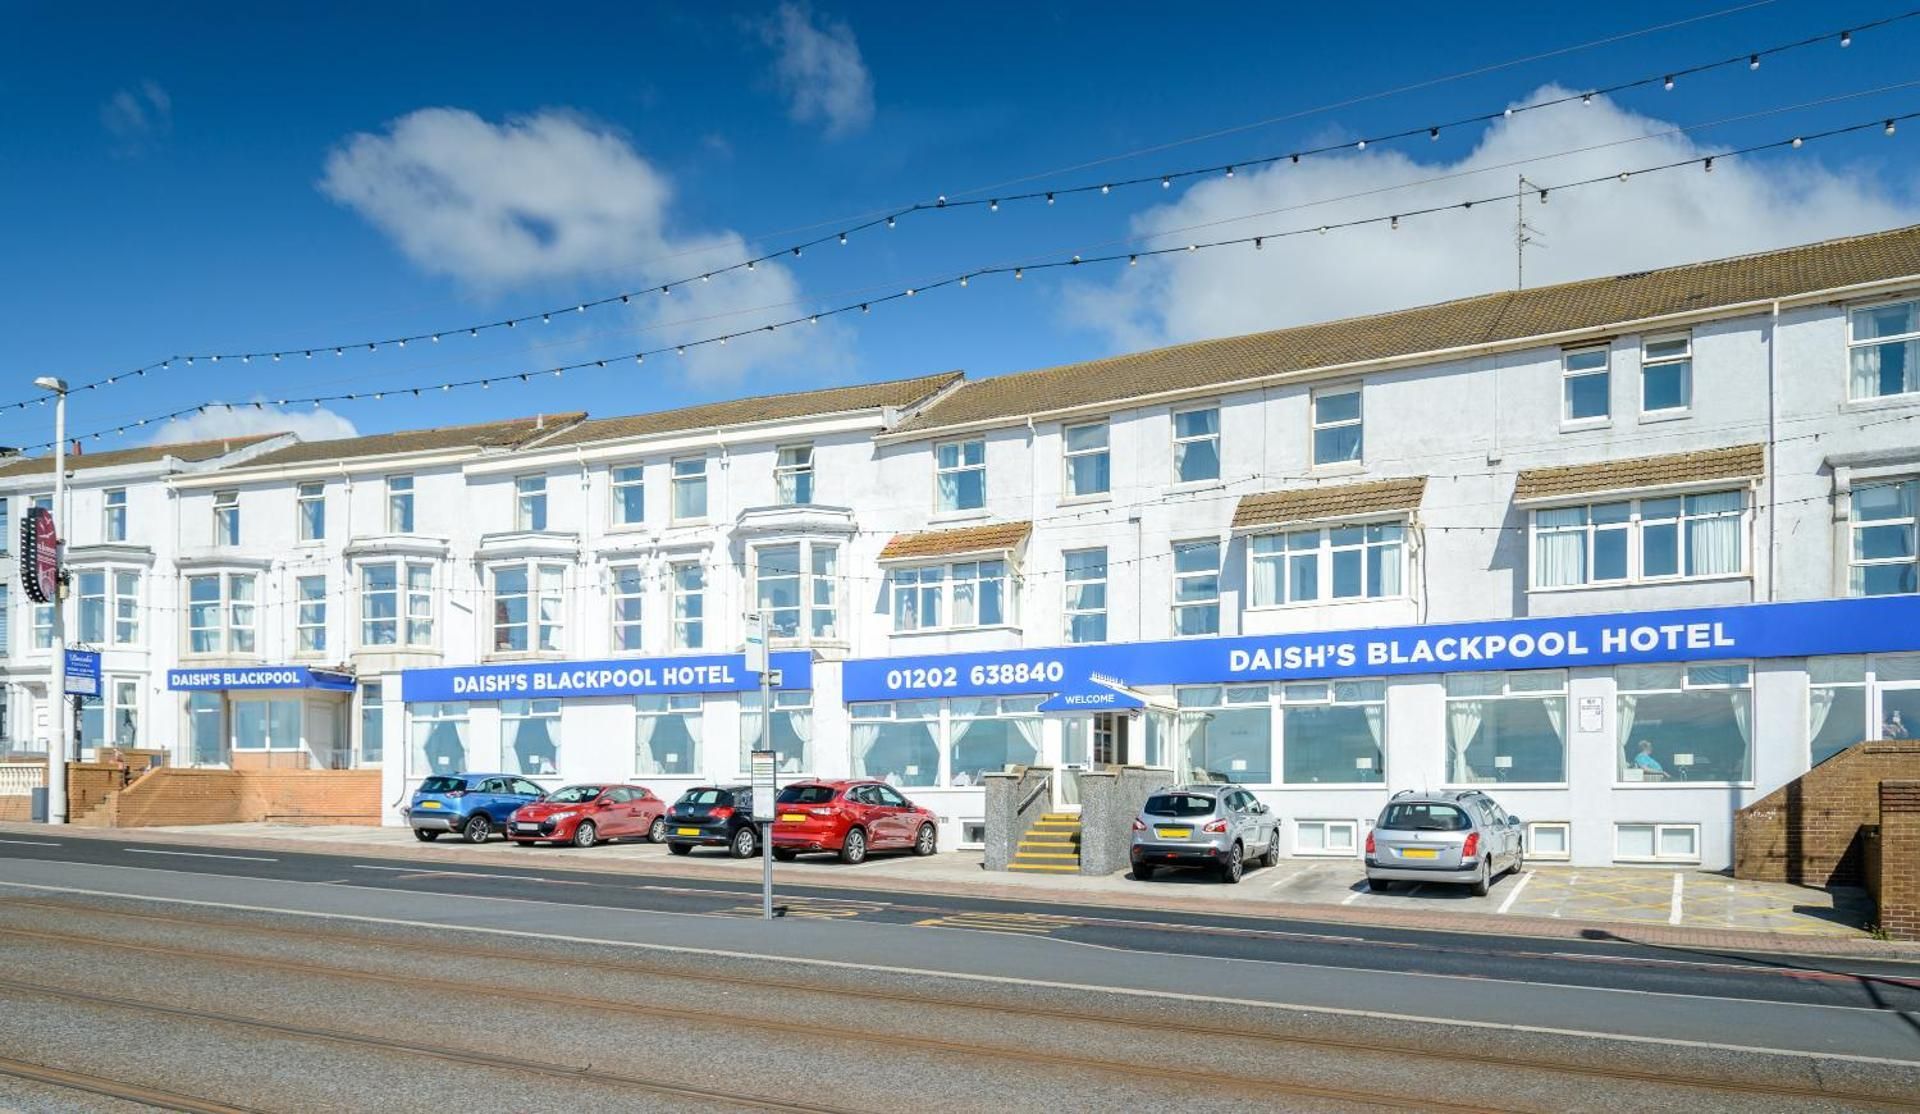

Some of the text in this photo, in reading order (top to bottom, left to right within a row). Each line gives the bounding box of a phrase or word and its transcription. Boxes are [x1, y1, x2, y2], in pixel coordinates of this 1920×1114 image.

[1229, 622, 1735, 672] DAISH'S BLACKPOOL HOTEL
[171, 671, 300, 686] DAISH'S BLACKPOOL
[453, 665, 736, 694] DAISH'S BLACKPOOL HOTEL
[886, 660, 1067, 690] 01202 638840
[1064, 693, 1115, 704] WELCOME
